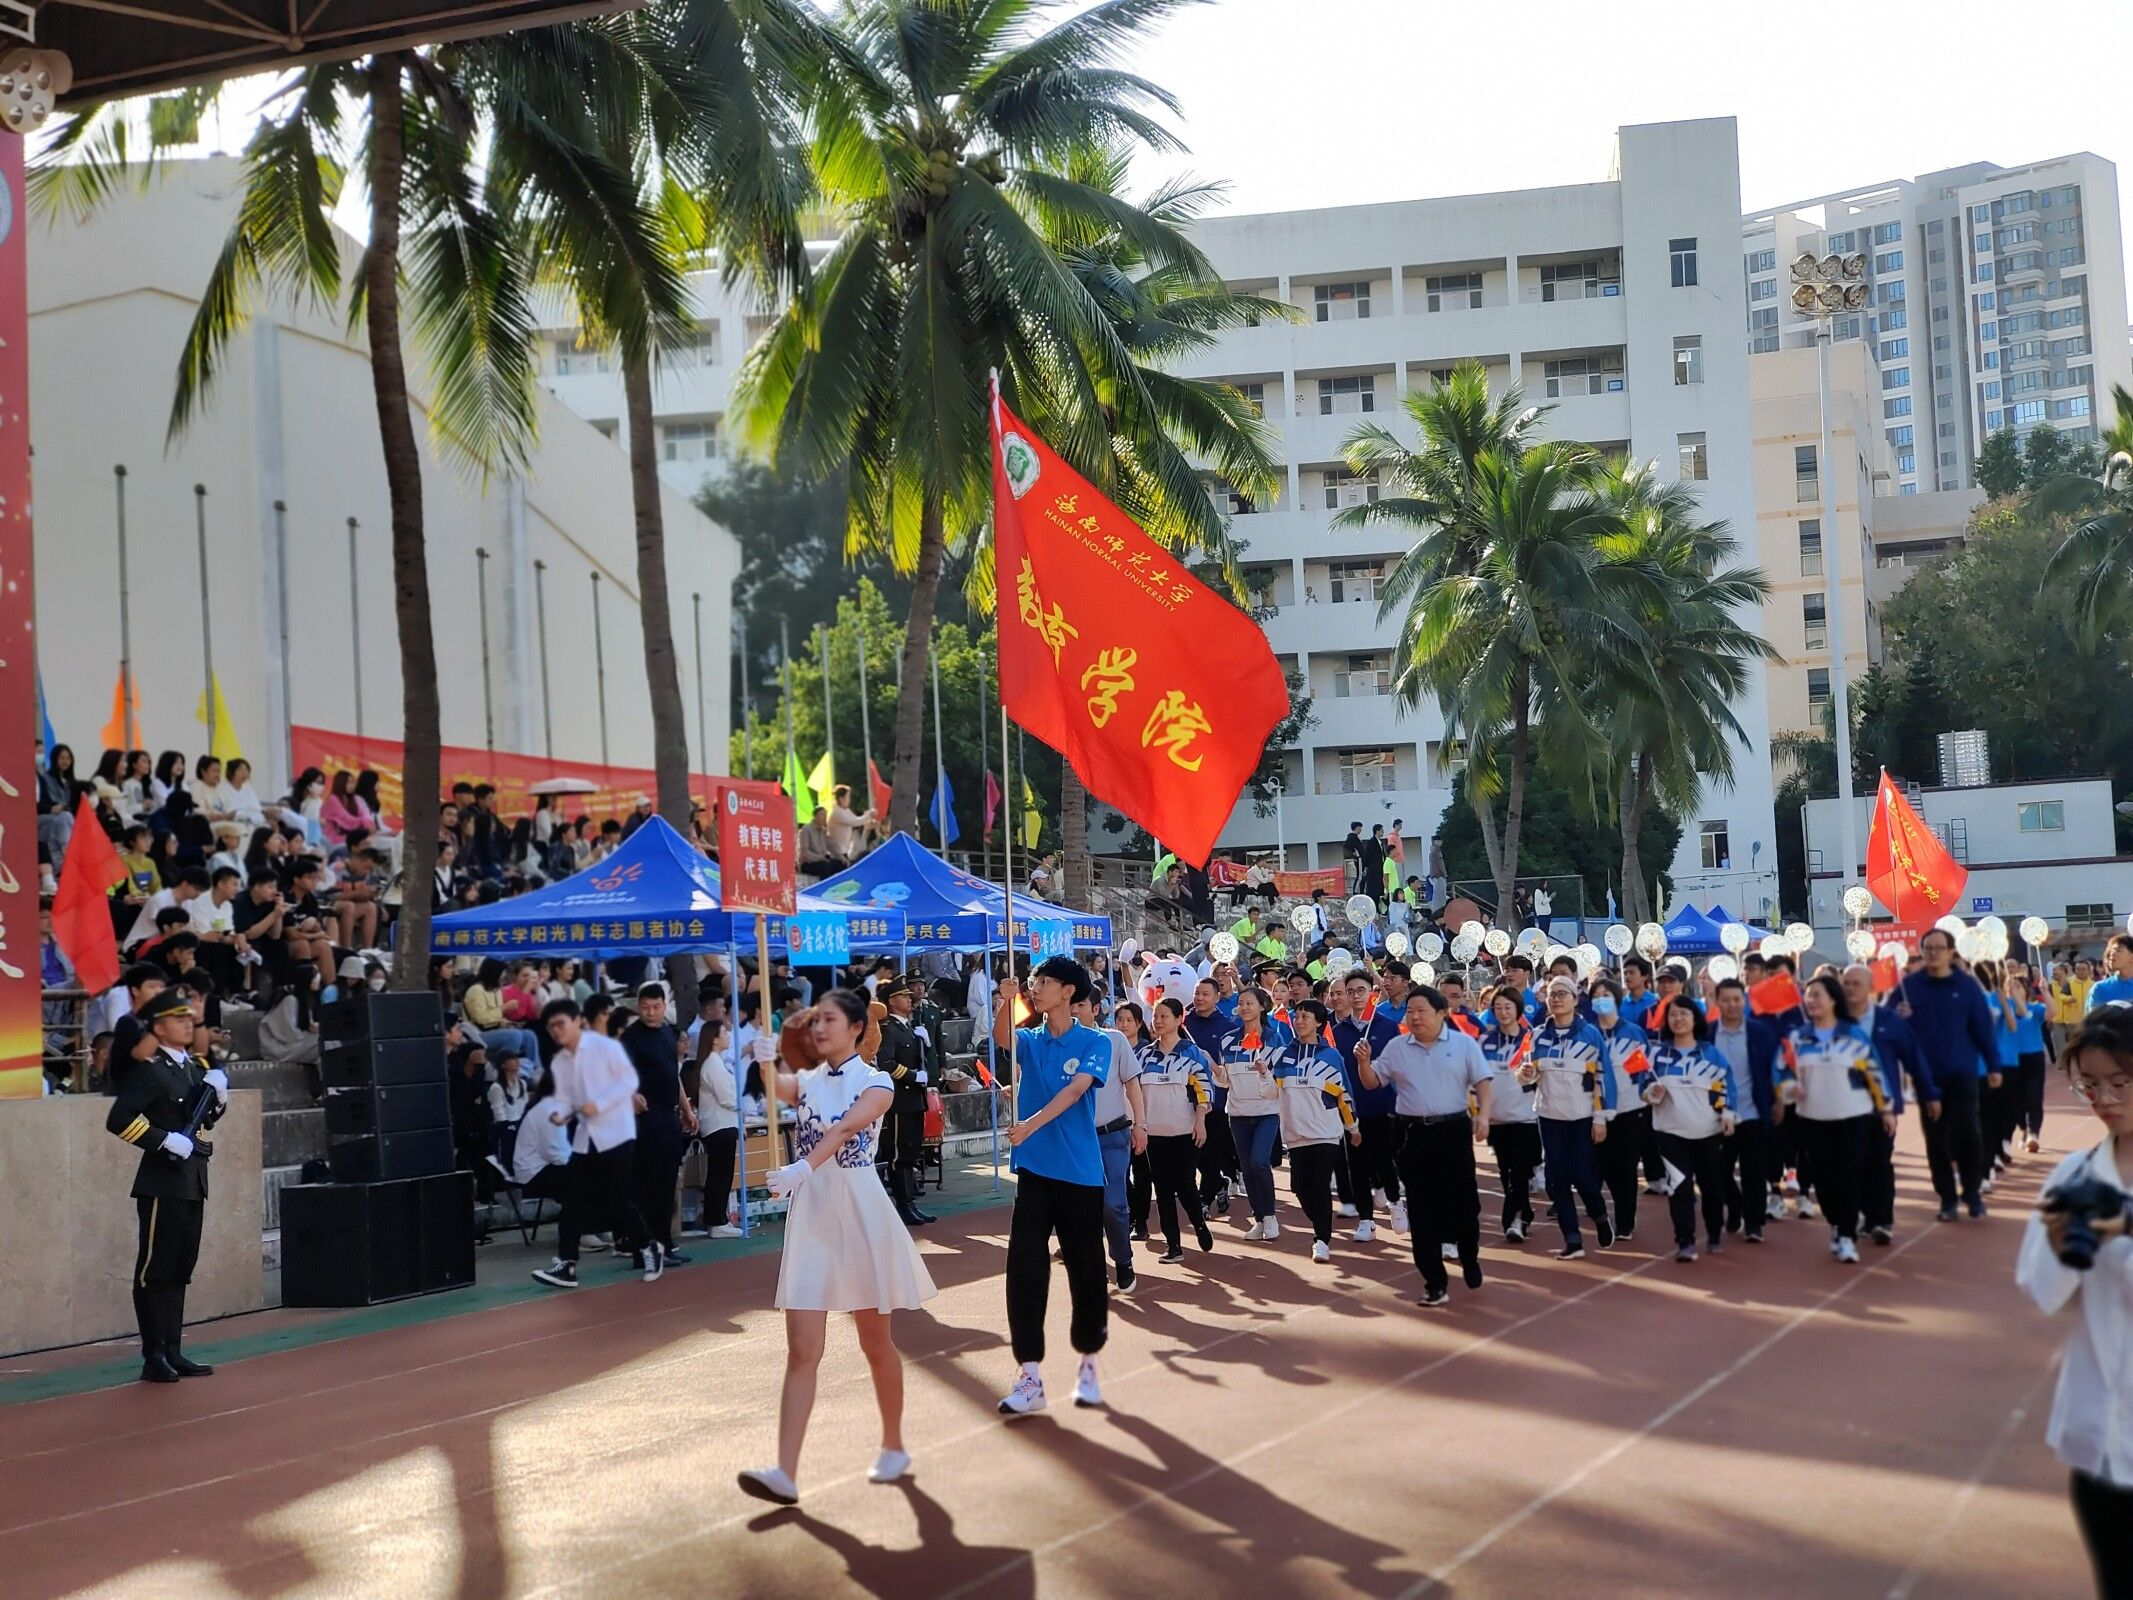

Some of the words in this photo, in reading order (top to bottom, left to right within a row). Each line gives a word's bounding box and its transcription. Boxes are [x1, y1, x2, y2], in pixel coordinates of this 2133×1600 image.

[1044, 508, 1082, 541] HAINAN
[1081, 534, 1121, 571] NORMAL
[1123, 568, 1177, 613] UNIVERSITY
[1054, 493, 1194, 603] 海南师范大学
[738, 822, 783, 853] 教育学院
[744, 856, 781, 883] 代表队
[803, 923, 849, 953] 音乐学院
